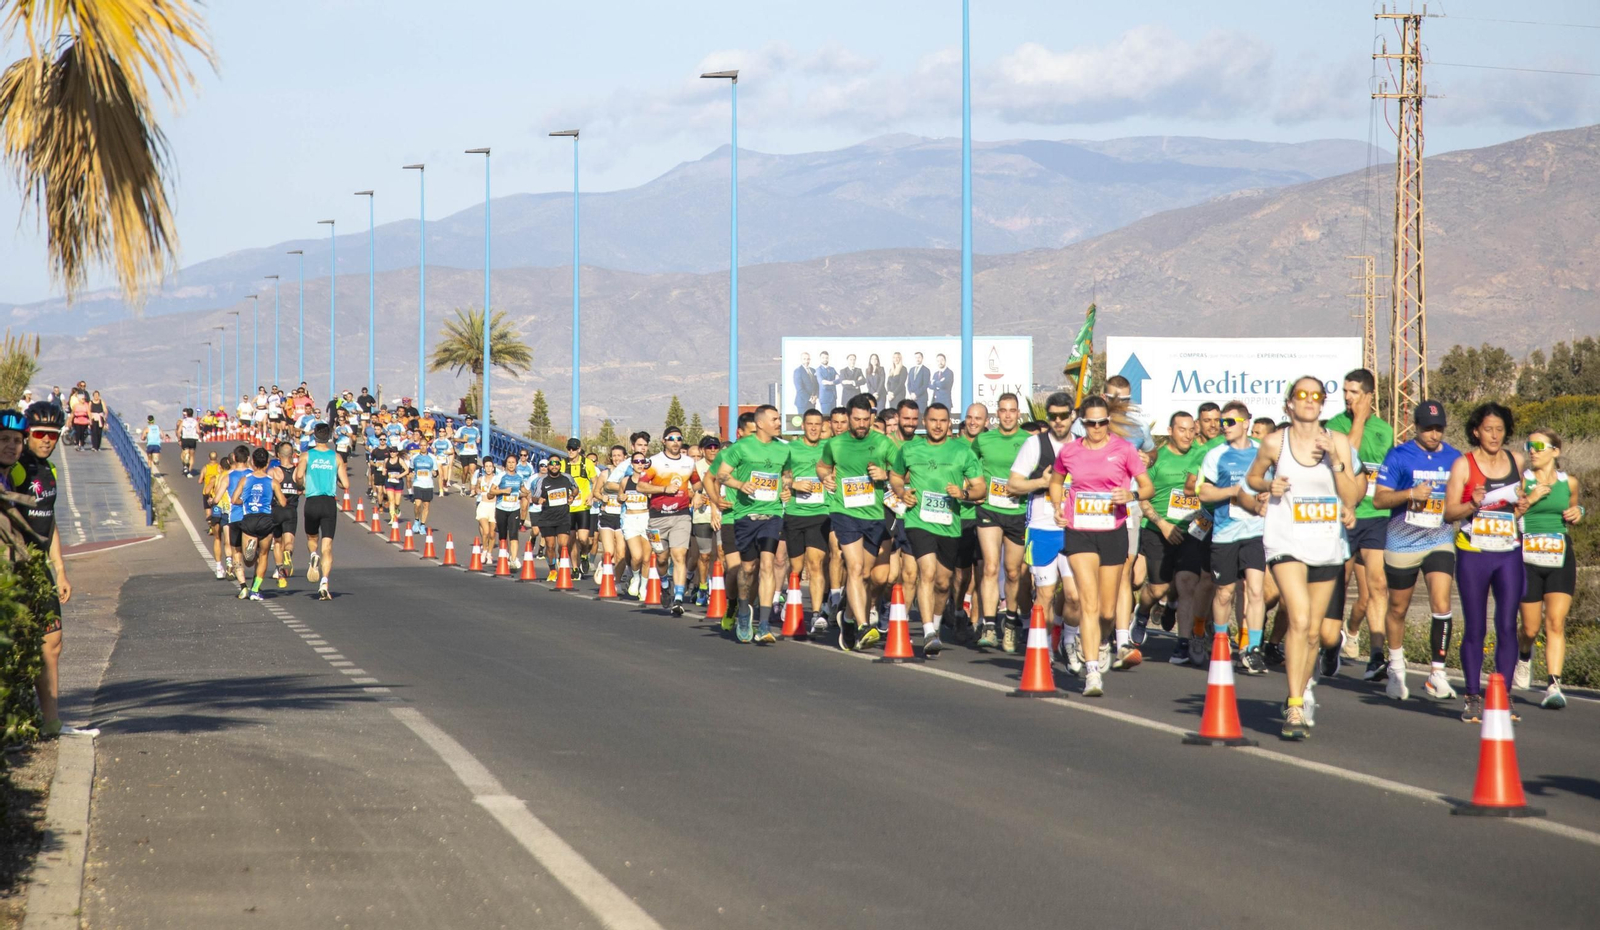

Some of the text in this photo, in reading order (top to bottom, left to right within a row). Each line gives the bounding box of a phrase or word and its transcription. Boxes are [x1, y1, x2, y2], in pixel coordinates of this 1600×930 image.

[1171, 370, 1338, 394] Mediterro
[754, 477, 777, 488] 2220
[846, 482, 872, 493] 2347
[1078, 499, 1111, 512] 1707
[1174, 495, 1199, 506] 2336
[1430, 499, 1442, 510] 15
[1297, 503, 1335, 518] 1015
[1529, 537, 1563, 551] 1125
